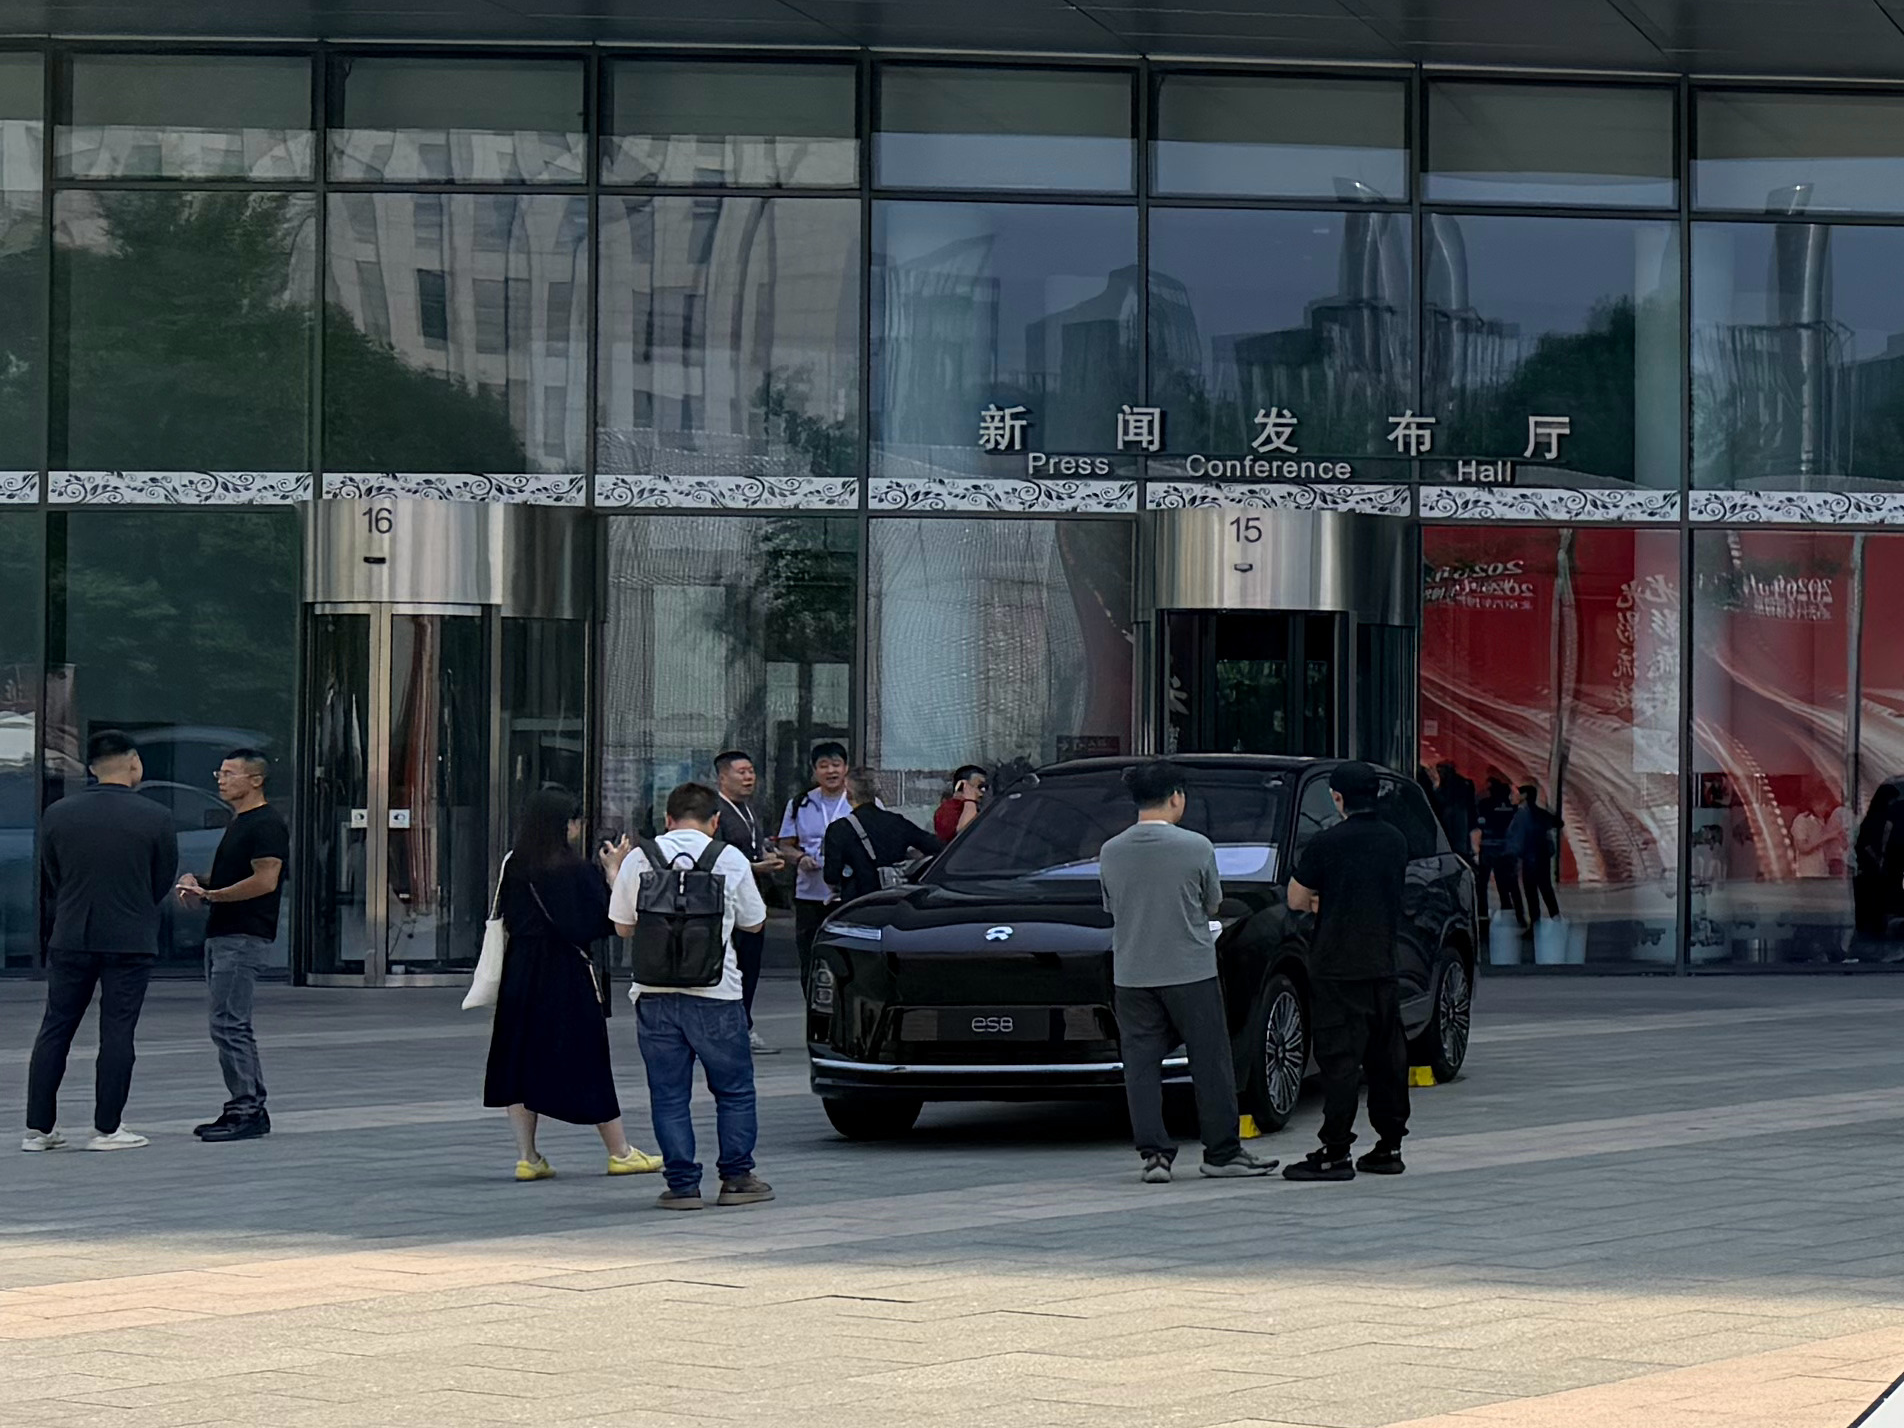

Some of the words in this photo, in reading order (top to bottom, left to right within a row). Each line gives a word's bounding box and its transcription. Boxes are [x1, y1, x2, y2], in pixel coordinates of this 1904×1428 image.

[979, 403, 1571, 460] 新闻发布厅
[1027, 452, 1110, 476] Press
[1185, 454, 1352, 479] Conference
[1457, 460, 1512, 483] Hall
[362, 506, 393, 534] 16
[1229, 516, 1263, 544] 15
